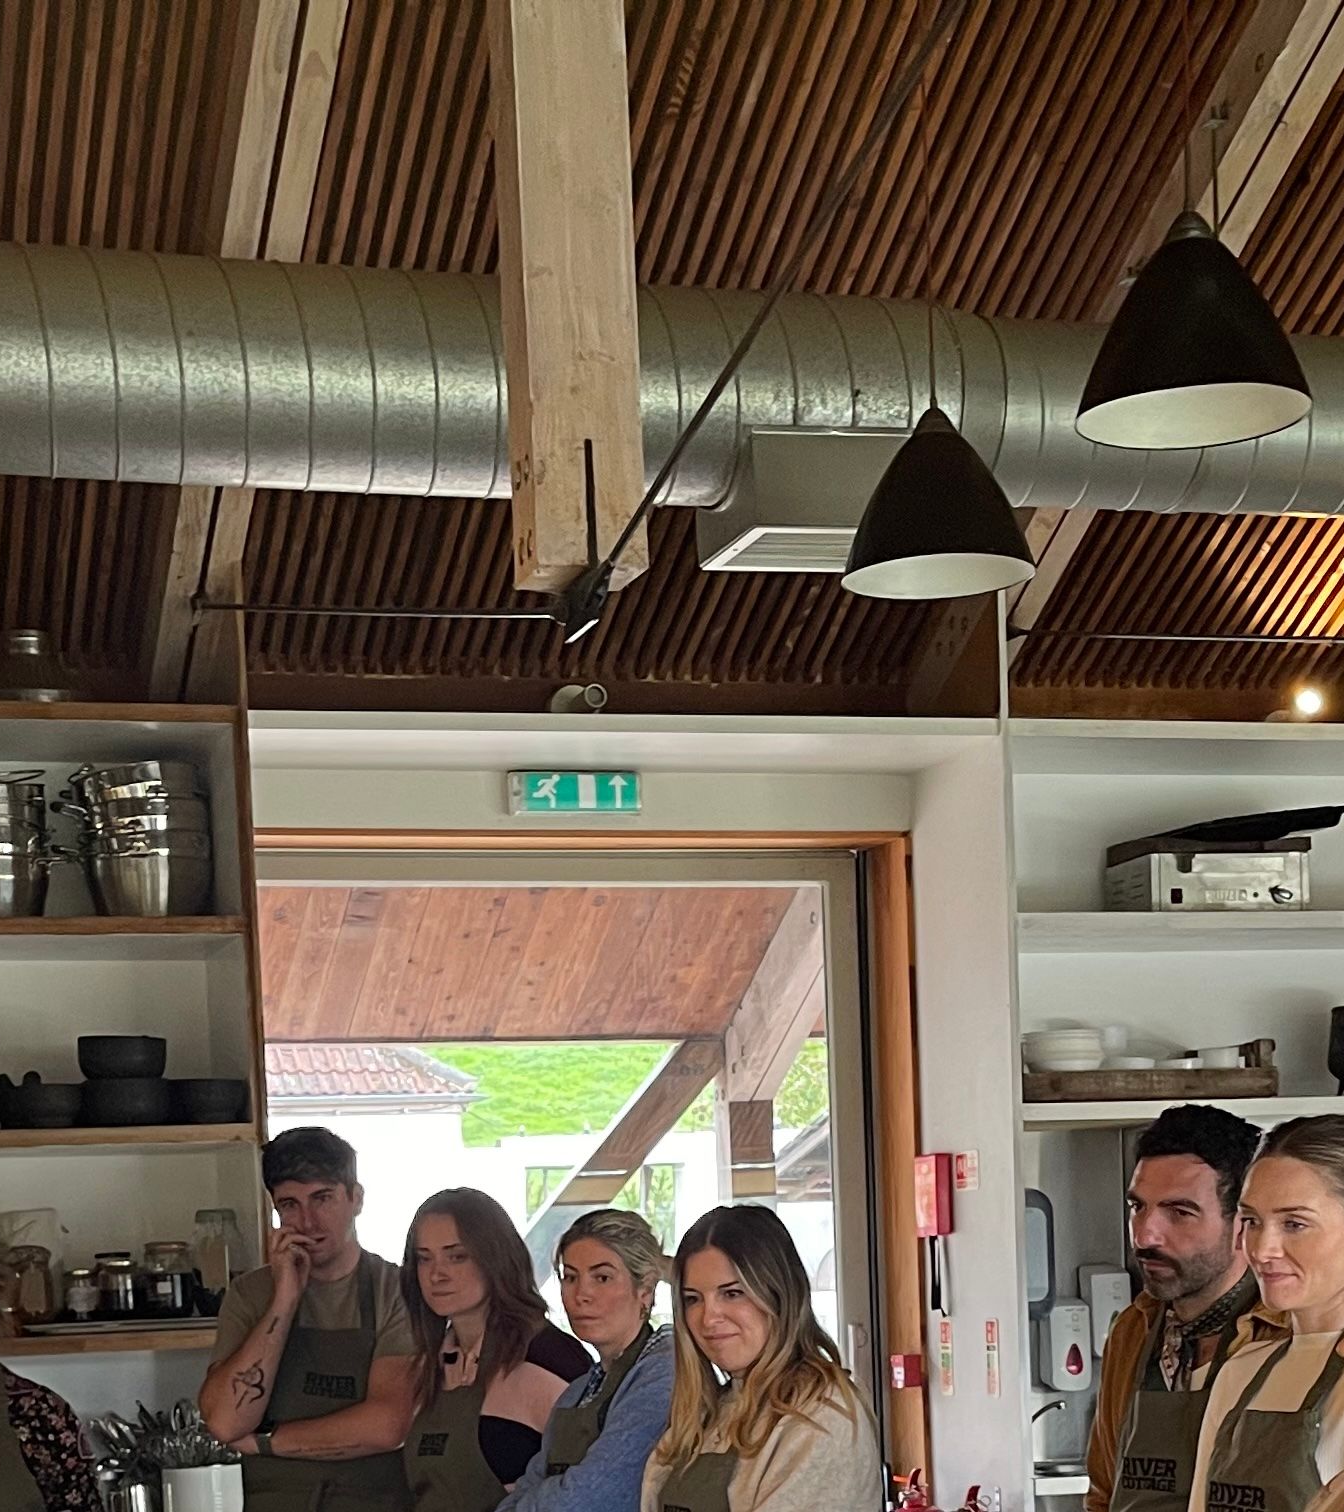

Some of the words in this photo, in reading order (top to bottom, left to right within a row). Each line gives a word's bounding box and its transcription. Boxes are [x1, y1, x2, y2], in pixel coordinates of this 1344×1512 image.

[1122, 1456, 1177, 1478] RIVER
[1121, 1475, 1176, 1493] COTTAGE
[1209, 1481, 1266, 1509] RIVER
